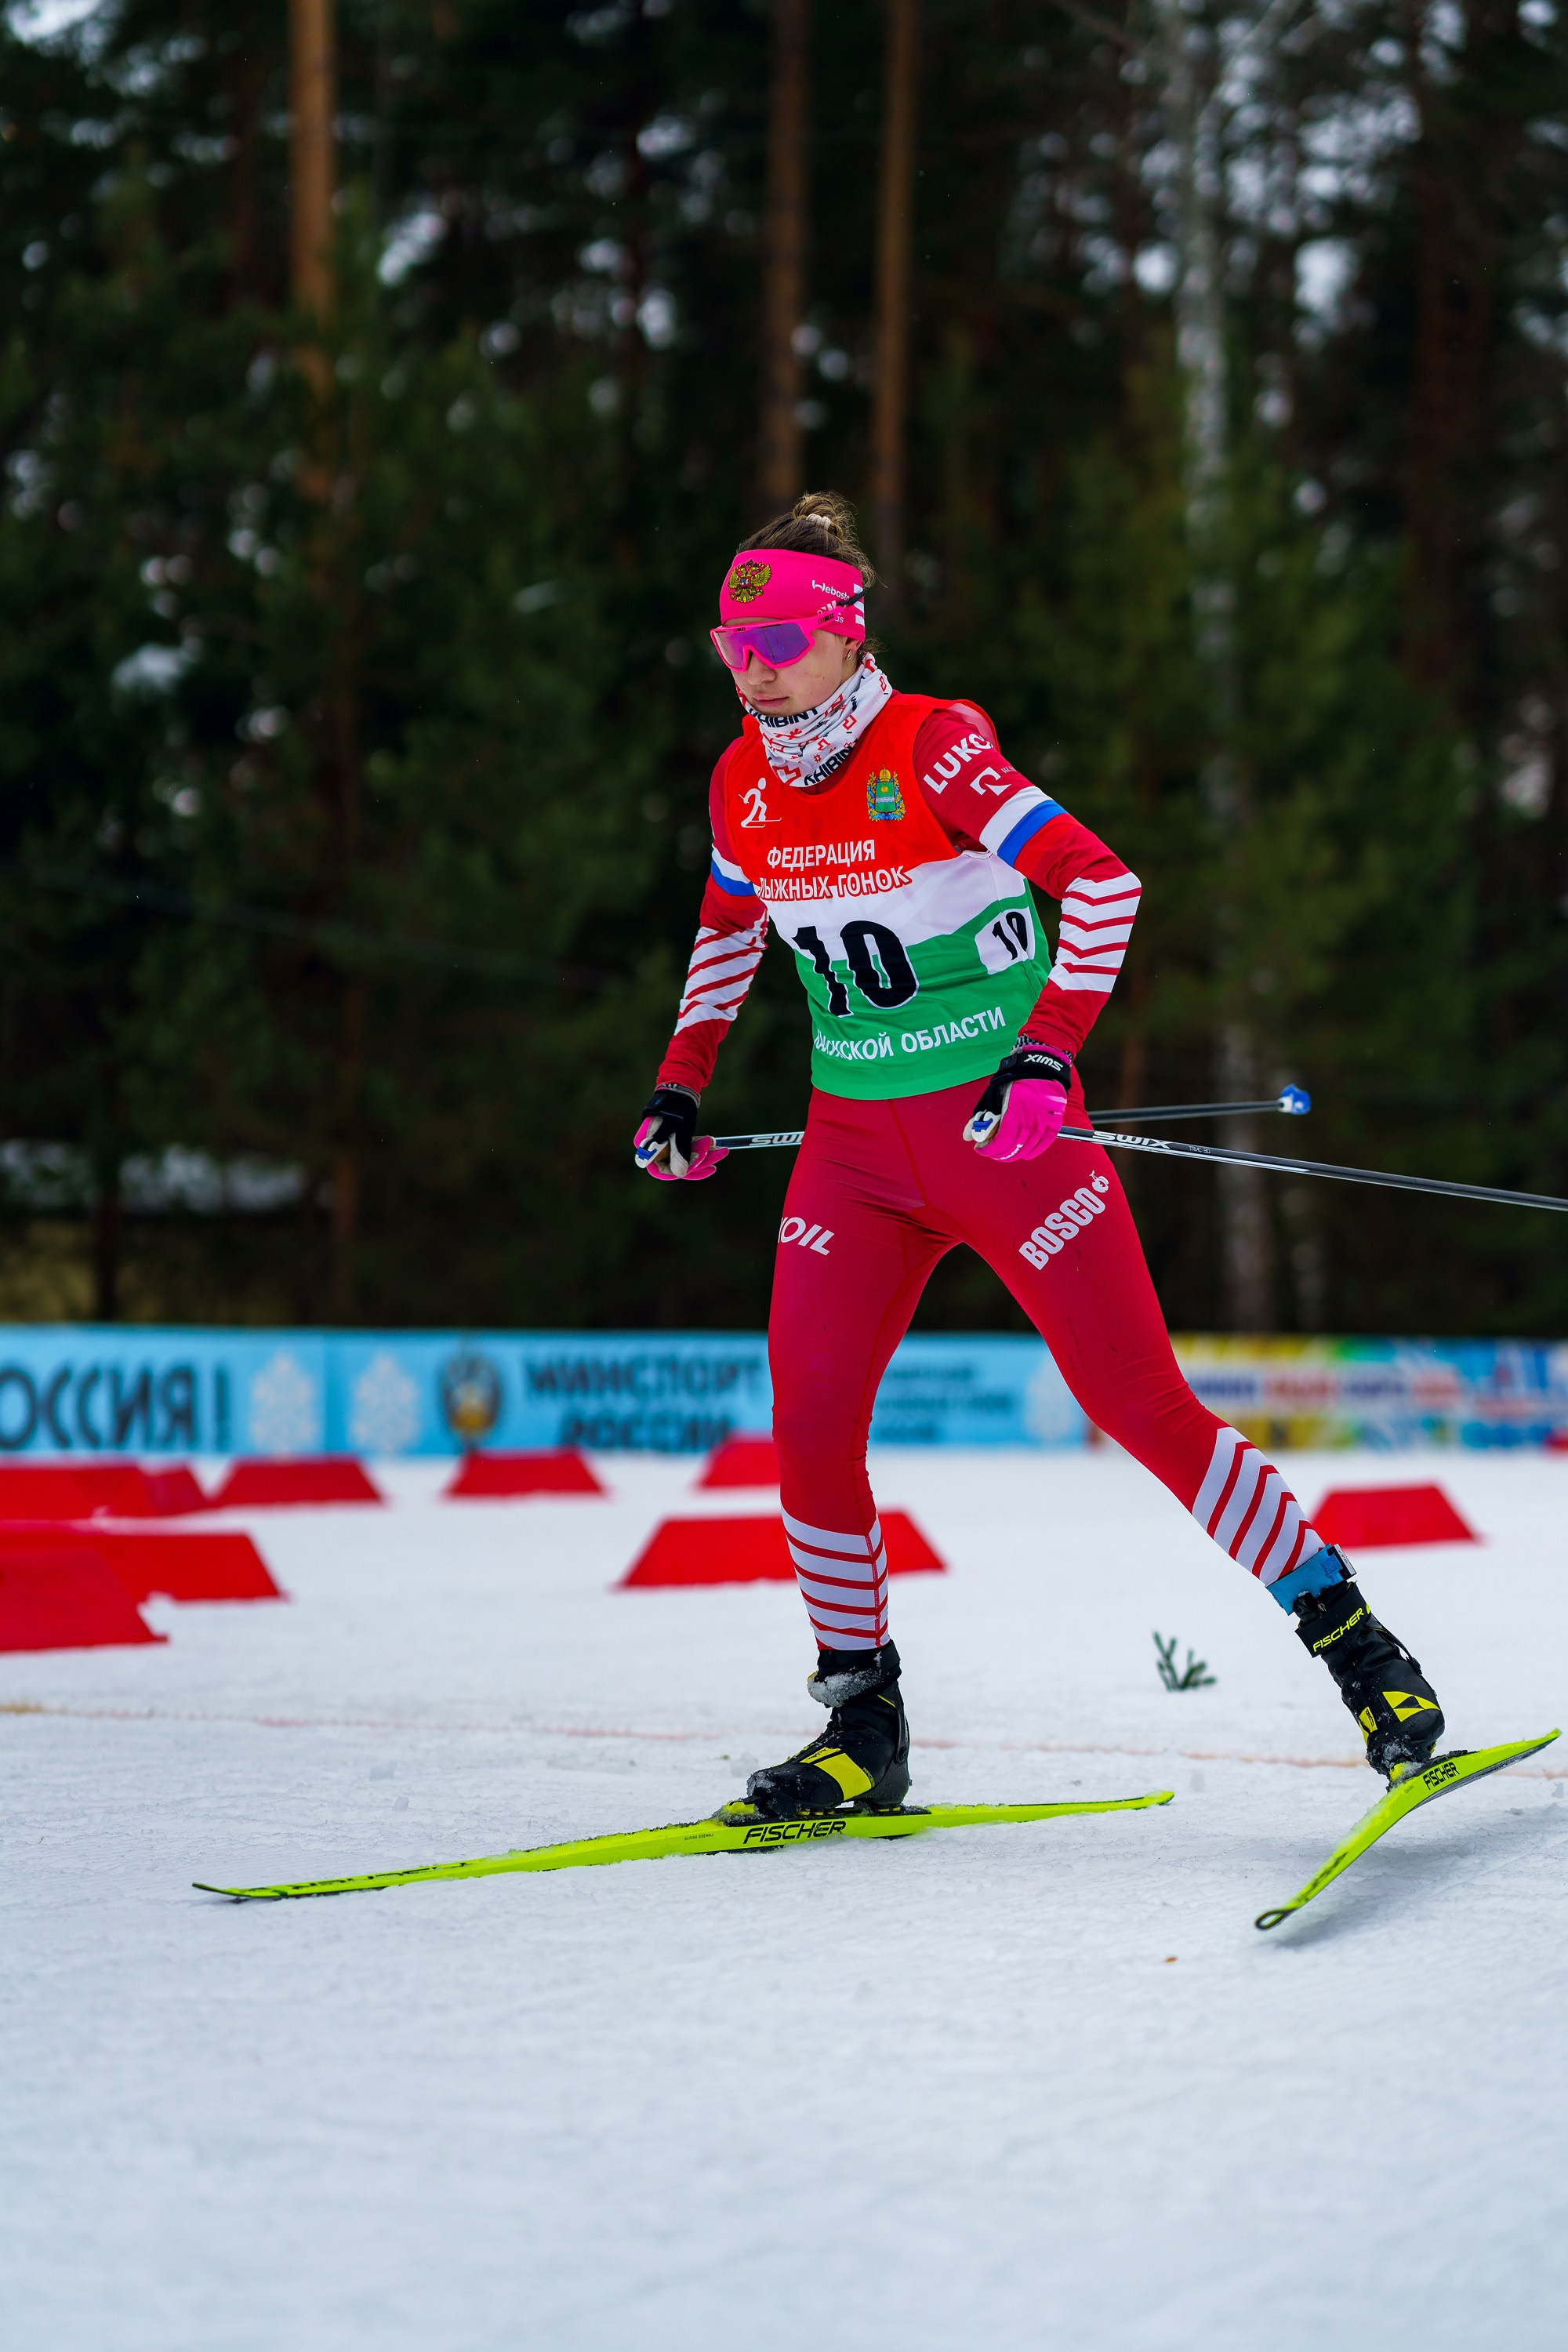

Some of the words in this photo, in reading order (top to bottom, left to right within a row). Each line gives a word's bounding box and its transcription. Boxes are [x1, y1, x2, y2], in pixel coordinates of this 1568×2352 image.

[804, 741, 855, 786] KHIBIN
[923, 733, 993, 794] LUKO
[767, 839, 876, 872] ФЕДЕРАЦИЯ
[837, 865, 911, 896] ГОНОК
[992, 911, 1028, 960] 10
[792, 920, 918, 1018] 10
[902, 1007, 1006, 1053] ОБЛАСТИ
[1024, 1054, 1063, 1072] SWIX
[750, 1134, 804, 1146] SWI
[1092, 1131, 1174, 1149] SWIX
[778, 1217, 836, 1255] OIL
[1018, 1187, 1105, 1270] BOSCO
[0, 1363, 229, 1450] ОССИЯ!
[1312, 1607, 1364, 1653] FISCHER
[1422, 1762, 1460, 1791] FISCHER
[742, 1820, 847, 1845] FISCHER
